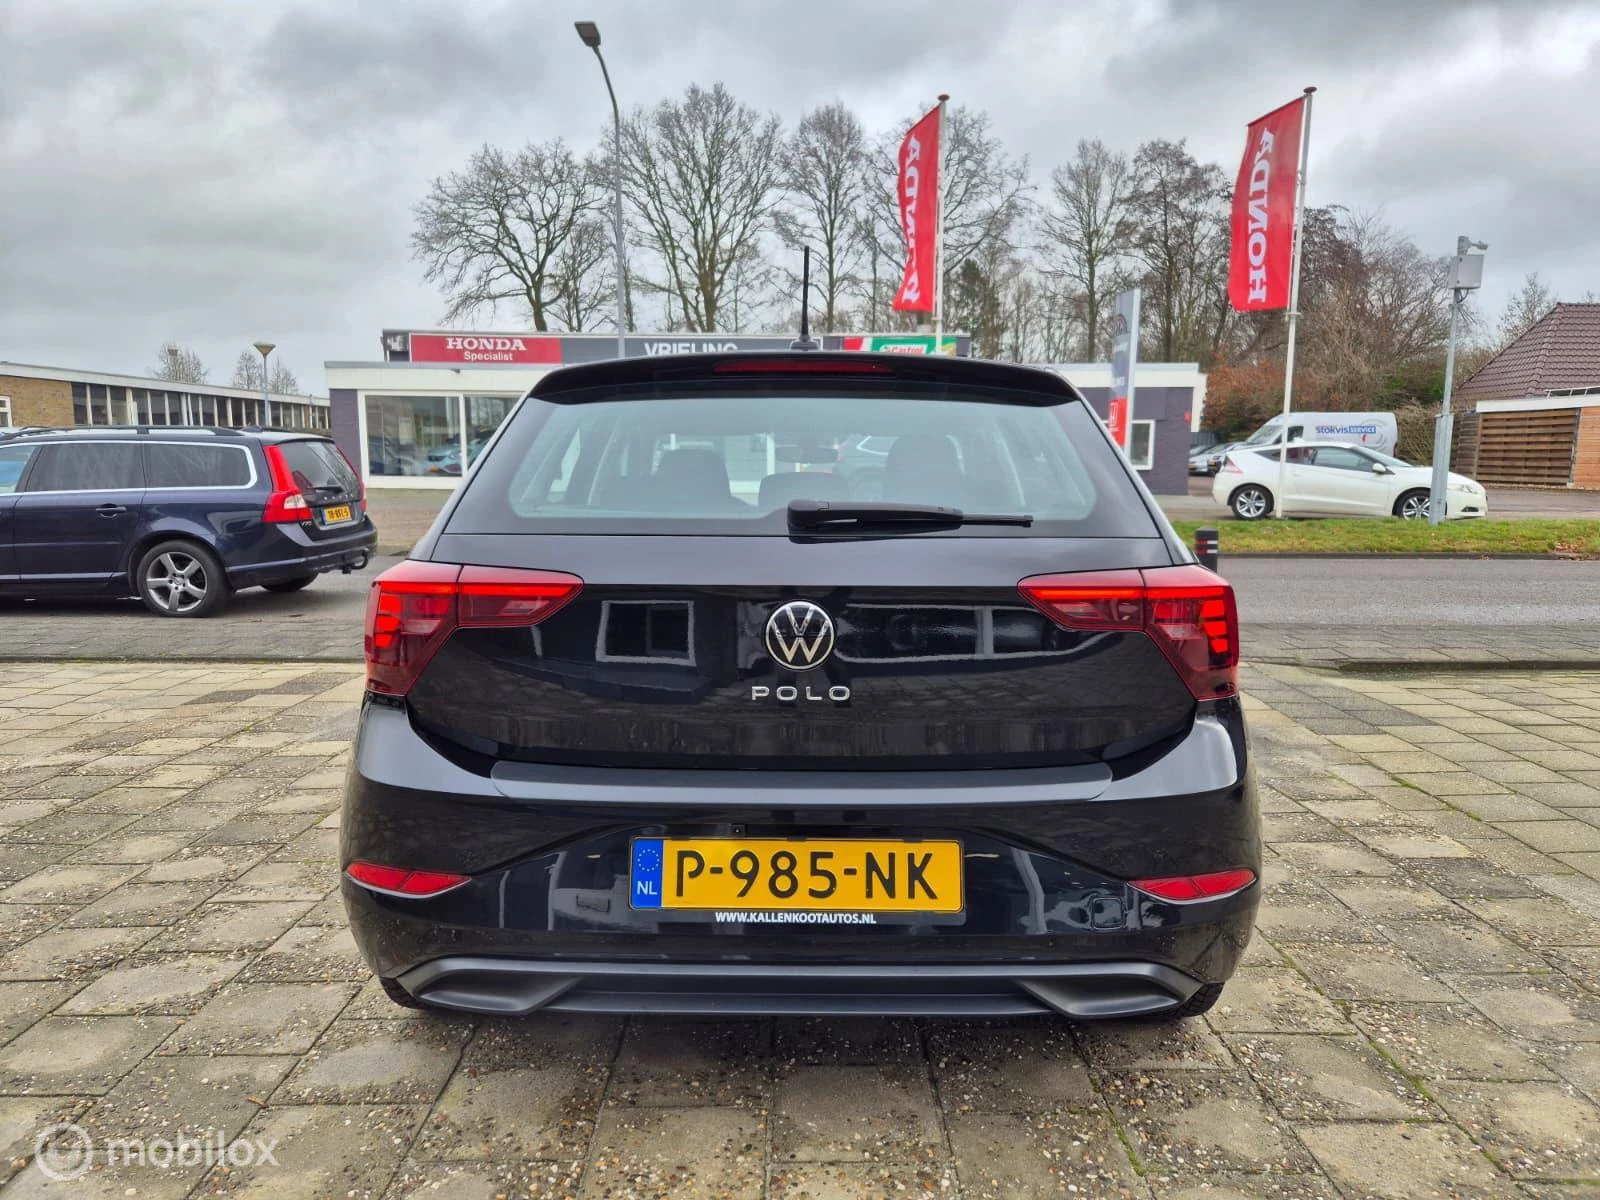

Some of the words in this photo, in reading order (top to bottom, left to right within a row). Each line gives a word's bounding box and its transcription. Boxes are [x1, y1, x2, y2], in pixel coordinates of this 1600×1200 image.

[1248, 127, 1275, 304] HONDA
[446, 337, 527, 351] HONDA
[464, 351, 513, 362] Specialist
[751, 686, 850, 700] POLO
[676, 850, 937, 900] P-985-NK
[637, 882, 658, 896] NL
[715, 911, 877, 925] WWW.KALLENKOOTAUTOS.NL
